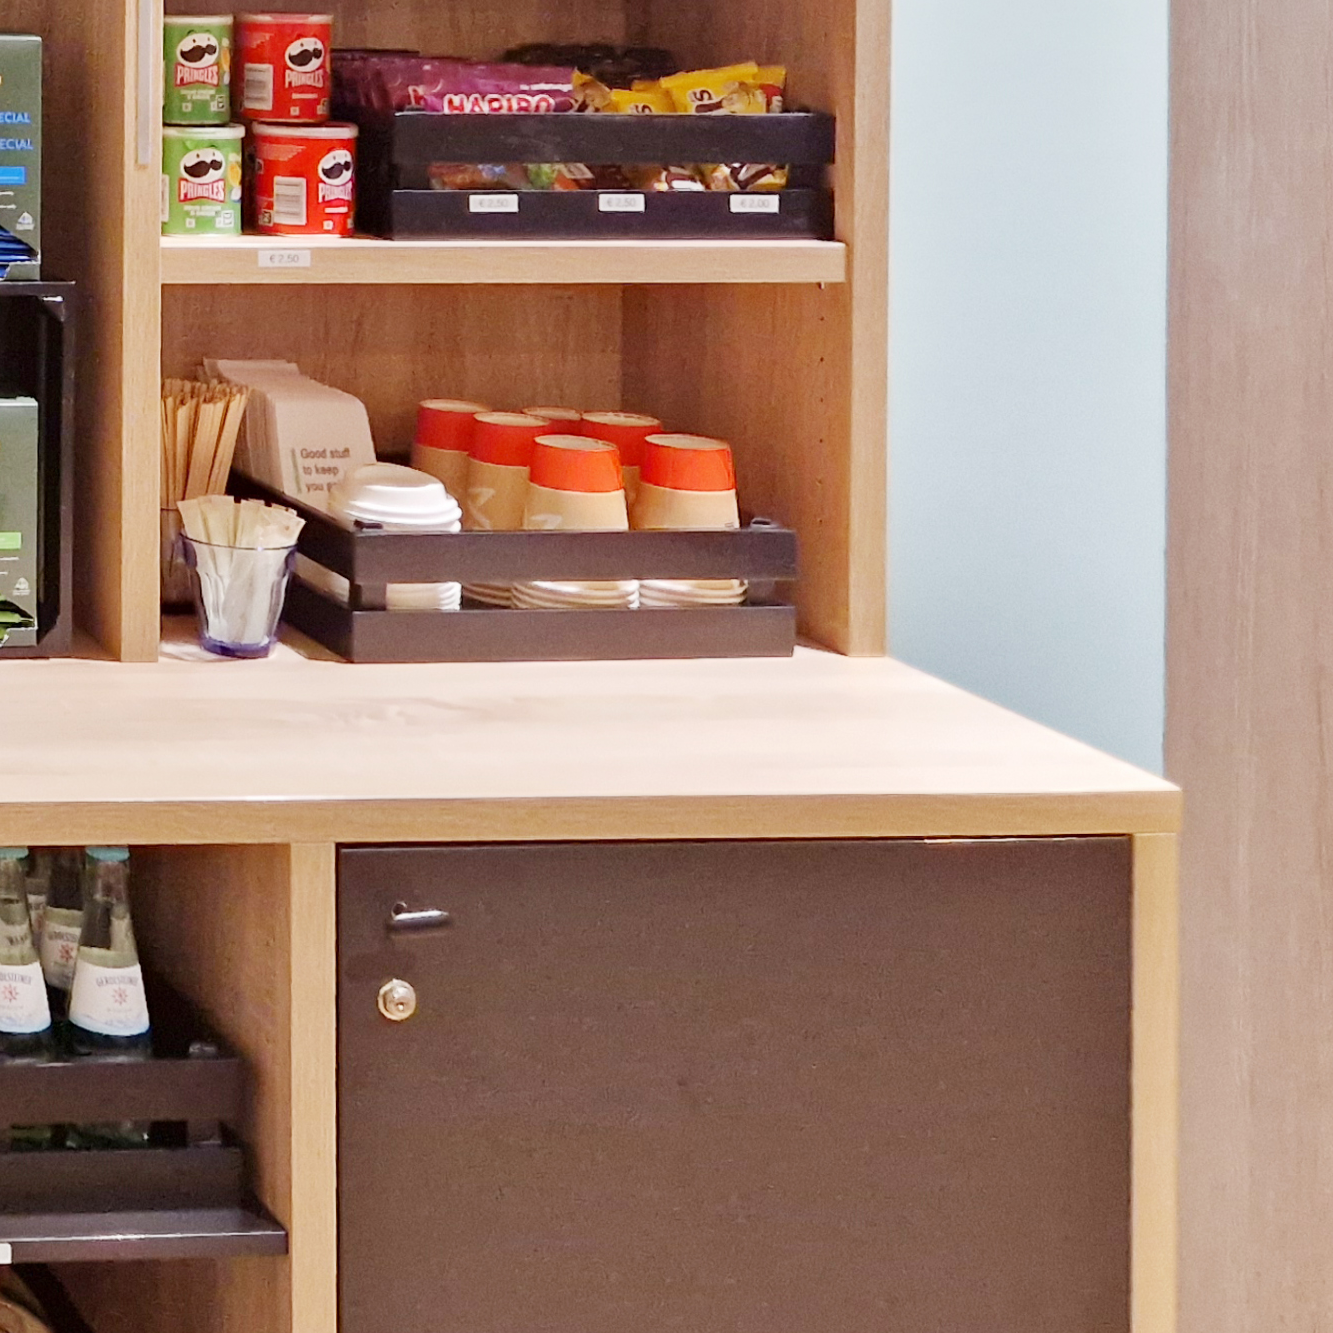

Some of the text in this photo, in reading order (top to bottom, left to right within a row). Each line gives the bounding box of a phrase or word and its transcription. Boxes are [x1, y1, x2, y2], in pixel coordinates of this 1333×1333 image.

[176, 66, 219, 87] PRINGLES
[285, 69, 324, 88] PRINGLES
[179, 180, 225, 202] PRINGLES
[318, 182, 352, 203] PRINGLES
[300, 447, 351, 460] Good stuff
[302, 464, 340, 478] to keep
[305, 484, 325, 493] you
